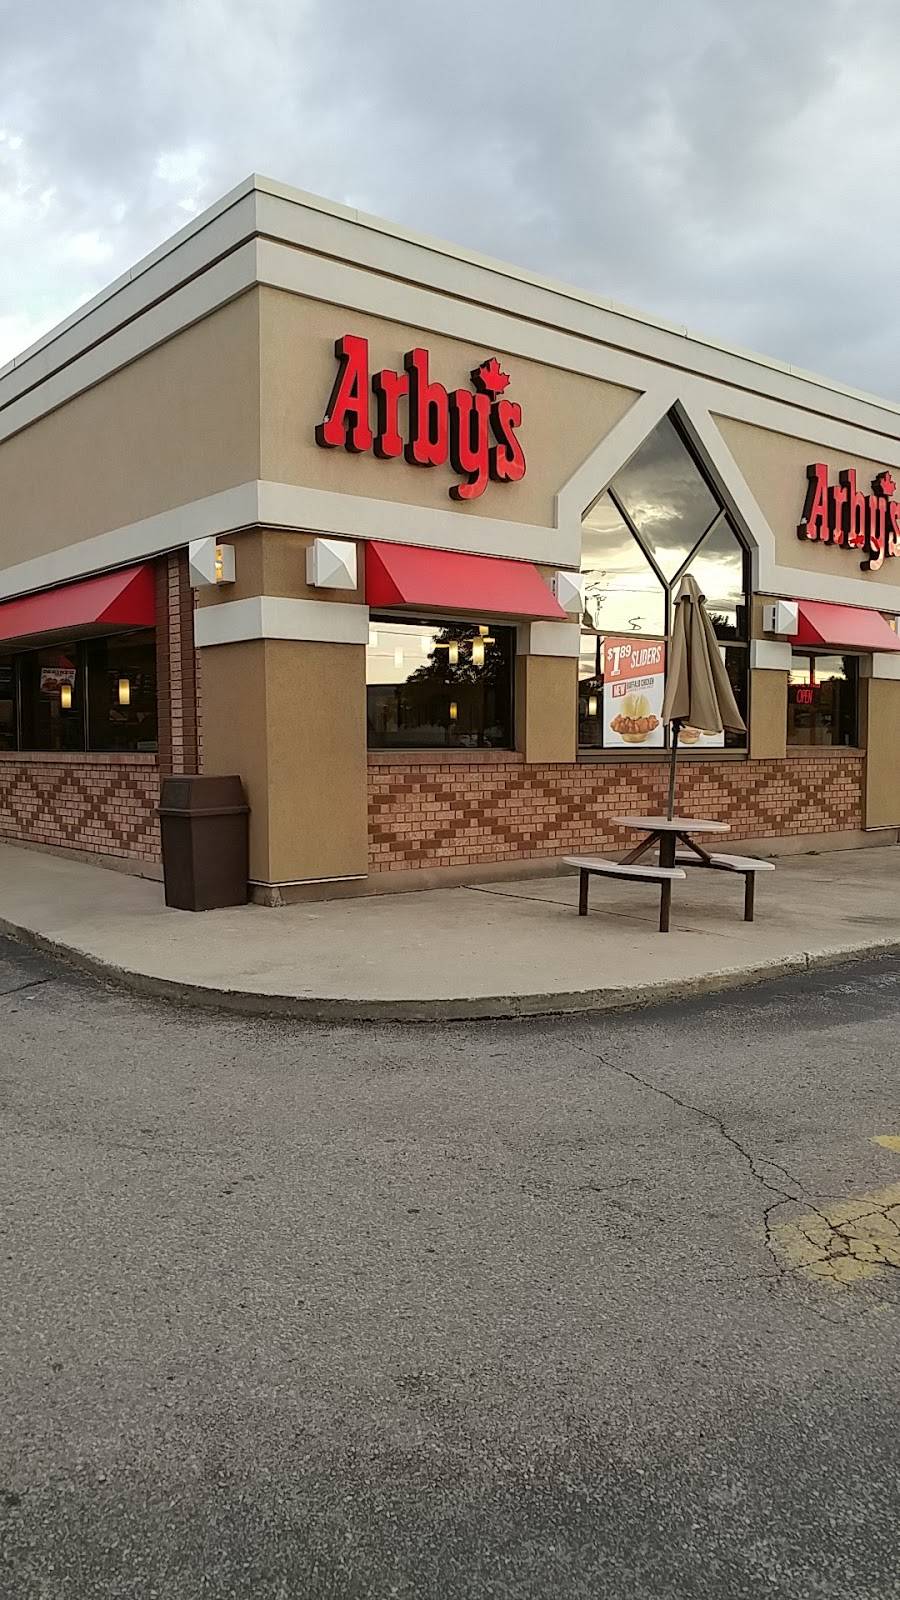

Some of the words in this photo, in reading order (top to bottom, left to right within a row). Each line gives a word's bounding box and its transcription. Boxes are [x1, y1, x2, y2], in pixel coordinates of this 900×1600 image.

[315, 335, 526, 500] Arby's
[630, 646, 661, 668] SLIDERS
[613, 684, 625, 697] NEW
[796, 689, 813, 704] OPEN
